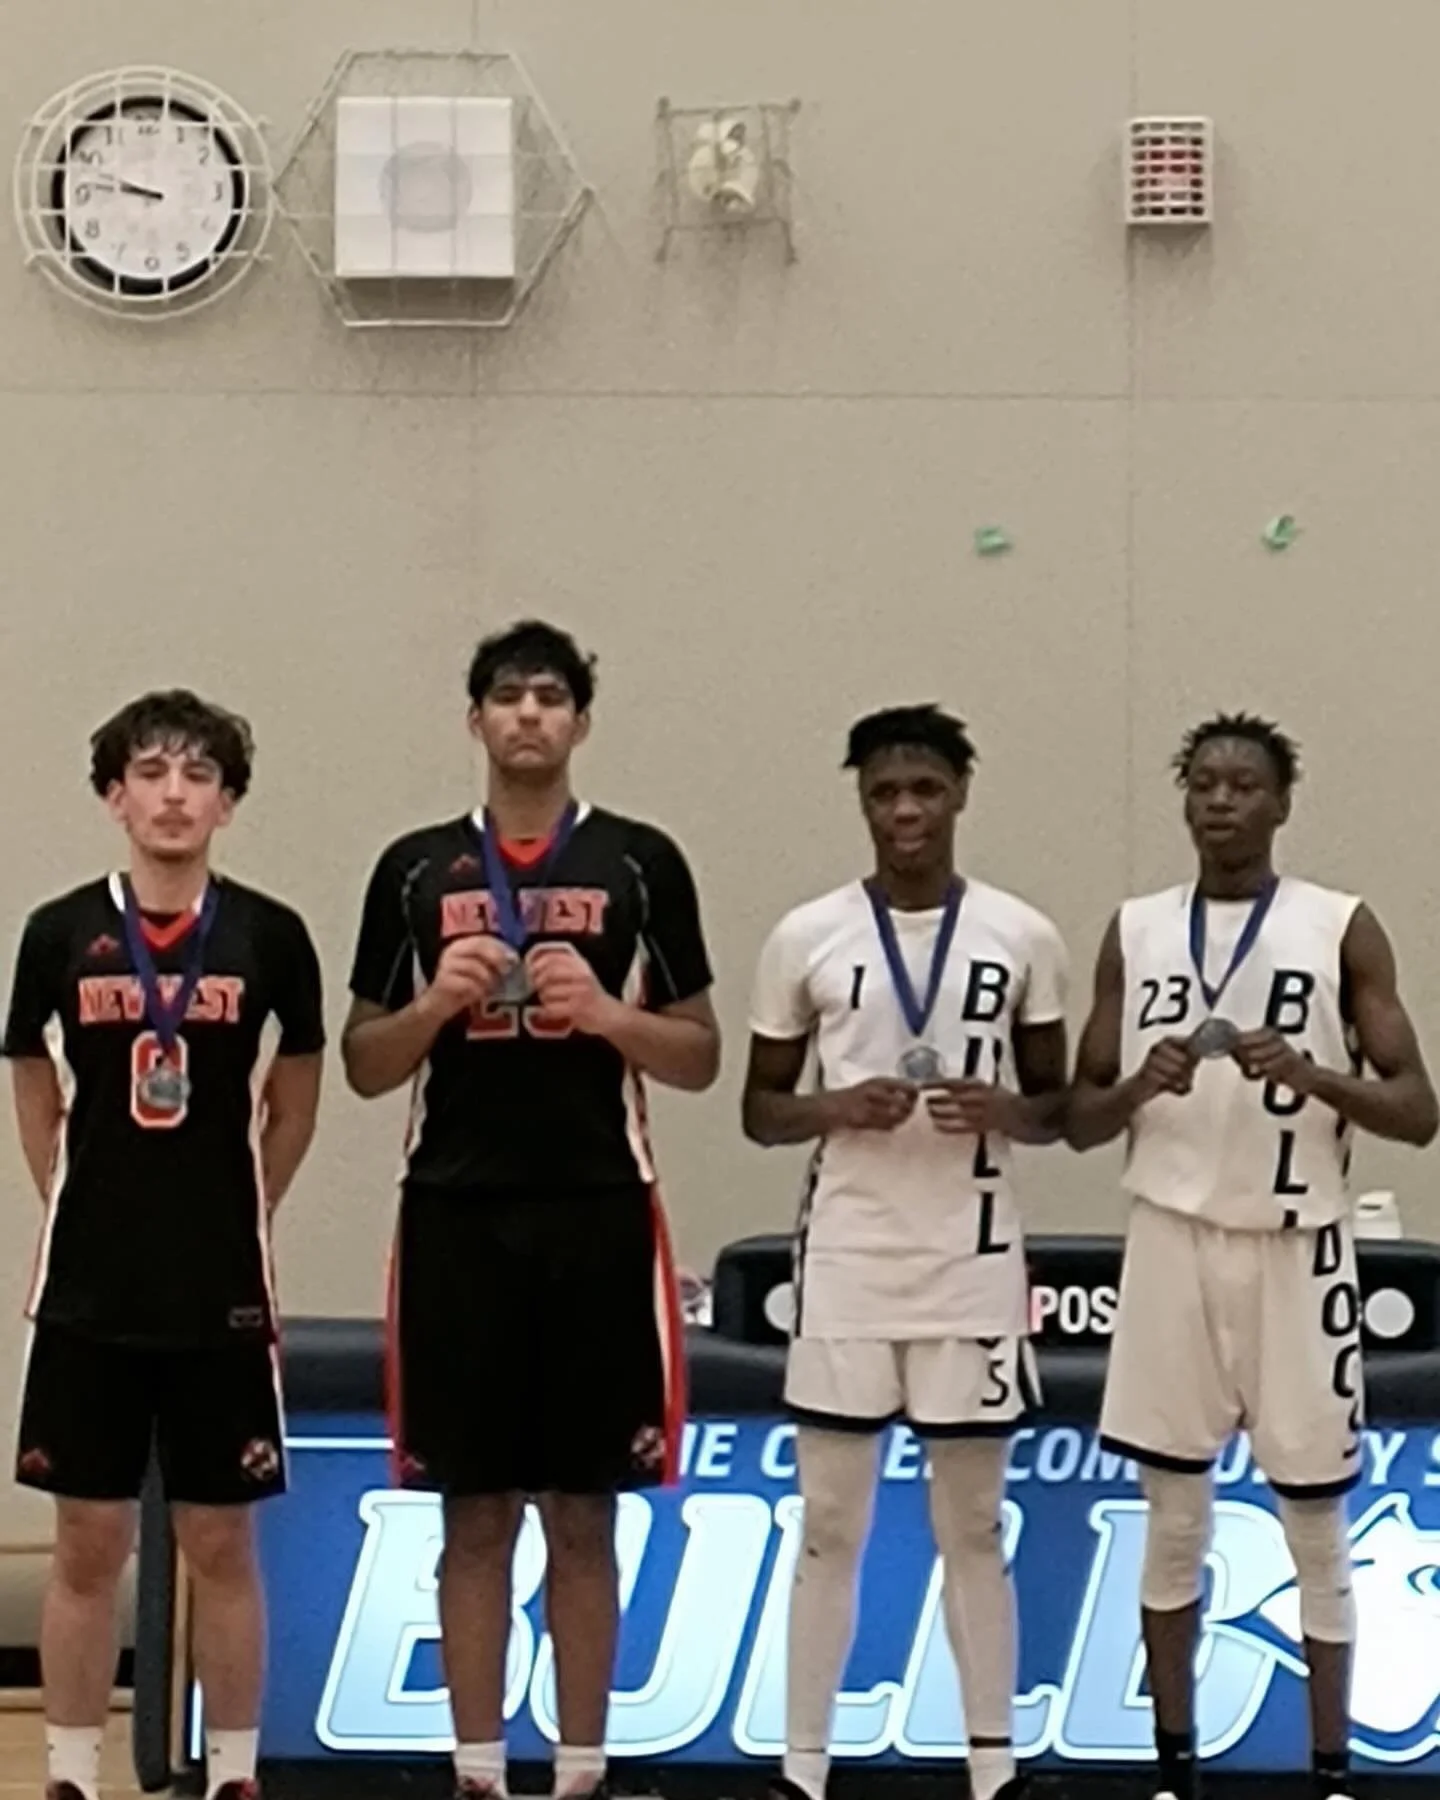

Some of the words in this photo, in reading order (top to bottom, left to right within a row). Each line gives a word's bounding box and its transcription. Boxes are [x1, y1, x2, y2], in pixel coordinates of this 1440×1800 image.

[848, 965, 866, 1010] 1
[1138, 975, 1191, 1029] 23
[1031, 1285, 1118, 1334] POS
